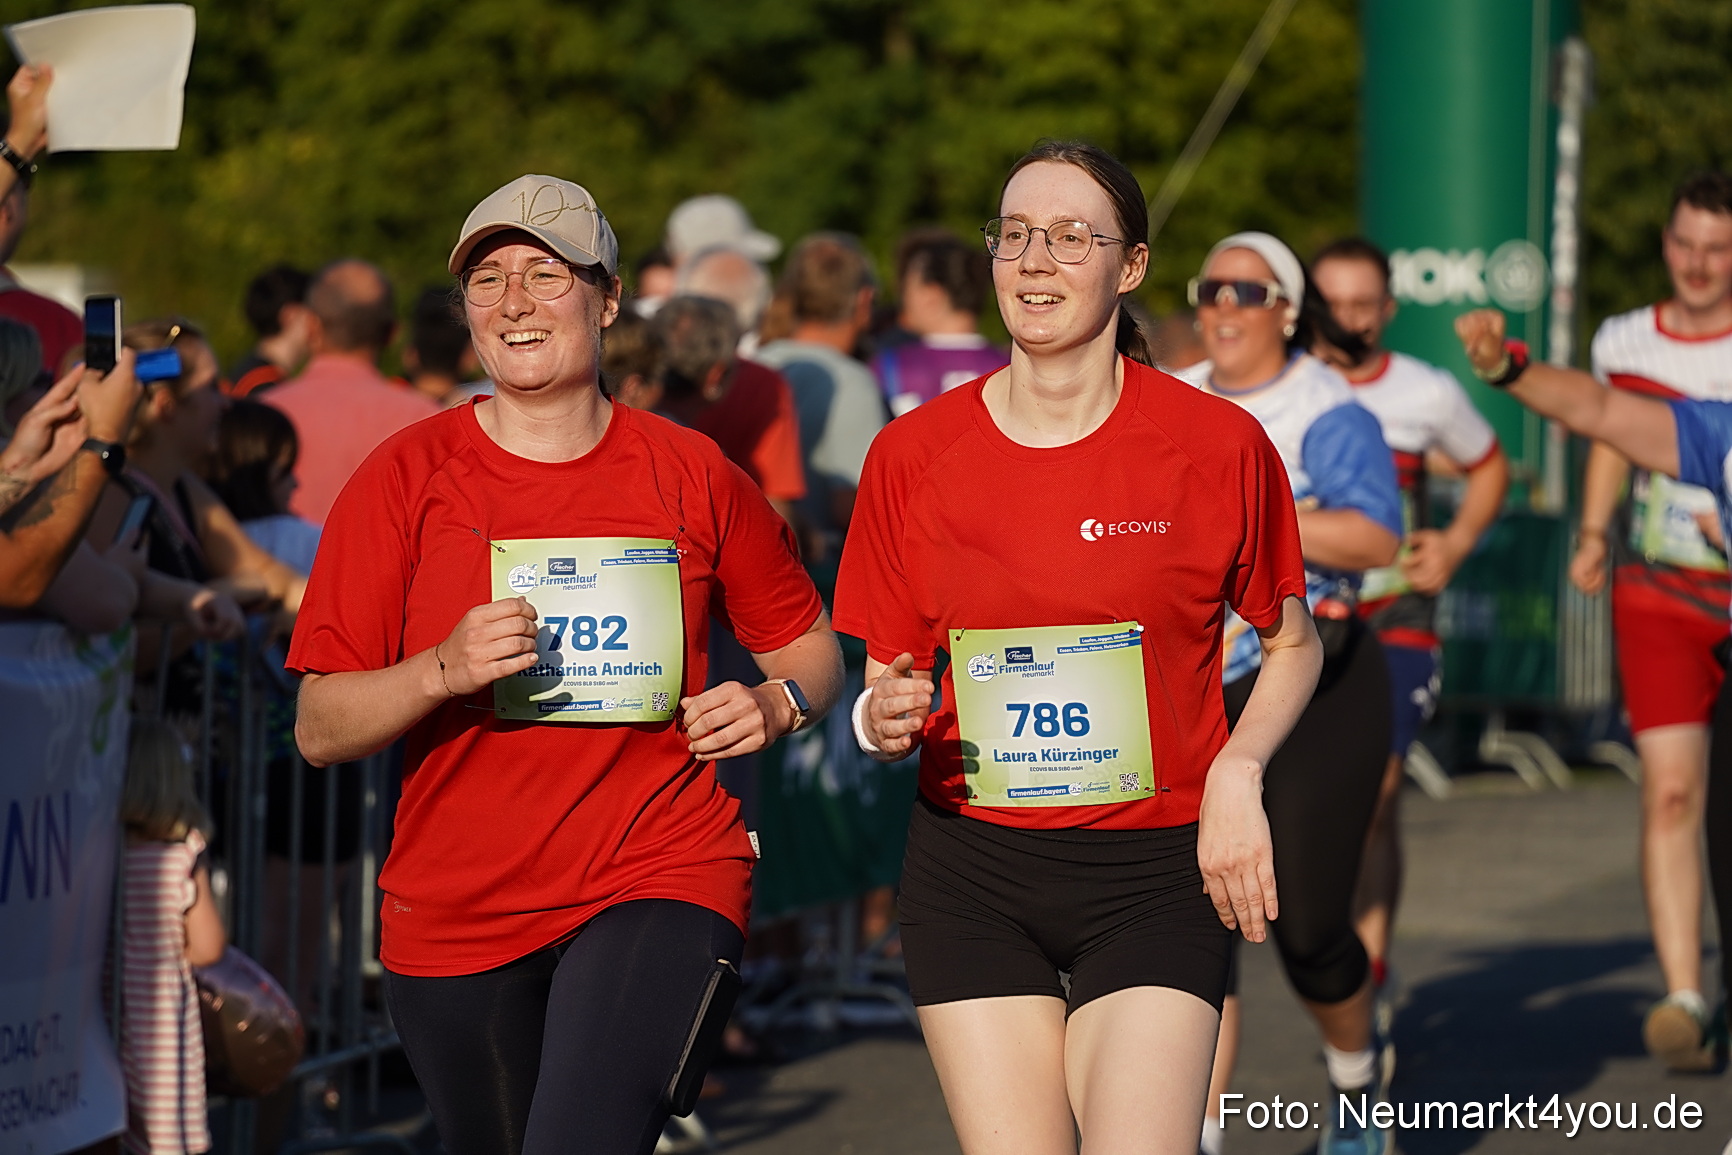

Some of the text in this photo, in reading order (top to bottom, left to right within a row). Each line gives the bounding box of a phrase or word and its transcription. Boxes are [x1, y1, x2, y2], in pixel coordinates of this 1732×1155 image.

[540, 573, 598, 586] Firmenlauf
[562, 583, 597, 591] neumarkt
[543, 615, 629, 651] 782
[601, 661, 663, 676] Andrich
[999, 661, 1055, 674] Firmenlauf
[1022, 670, 1055, 678] neumarkt
[541, 703, 600, 711] firmenlauf.bayern
[1006, 702, 1091, 738] 786
[993, 747, 1119, 764] Laura Kürzinger
[1010, 788, 1067, 797] firmenlauf.bayern
